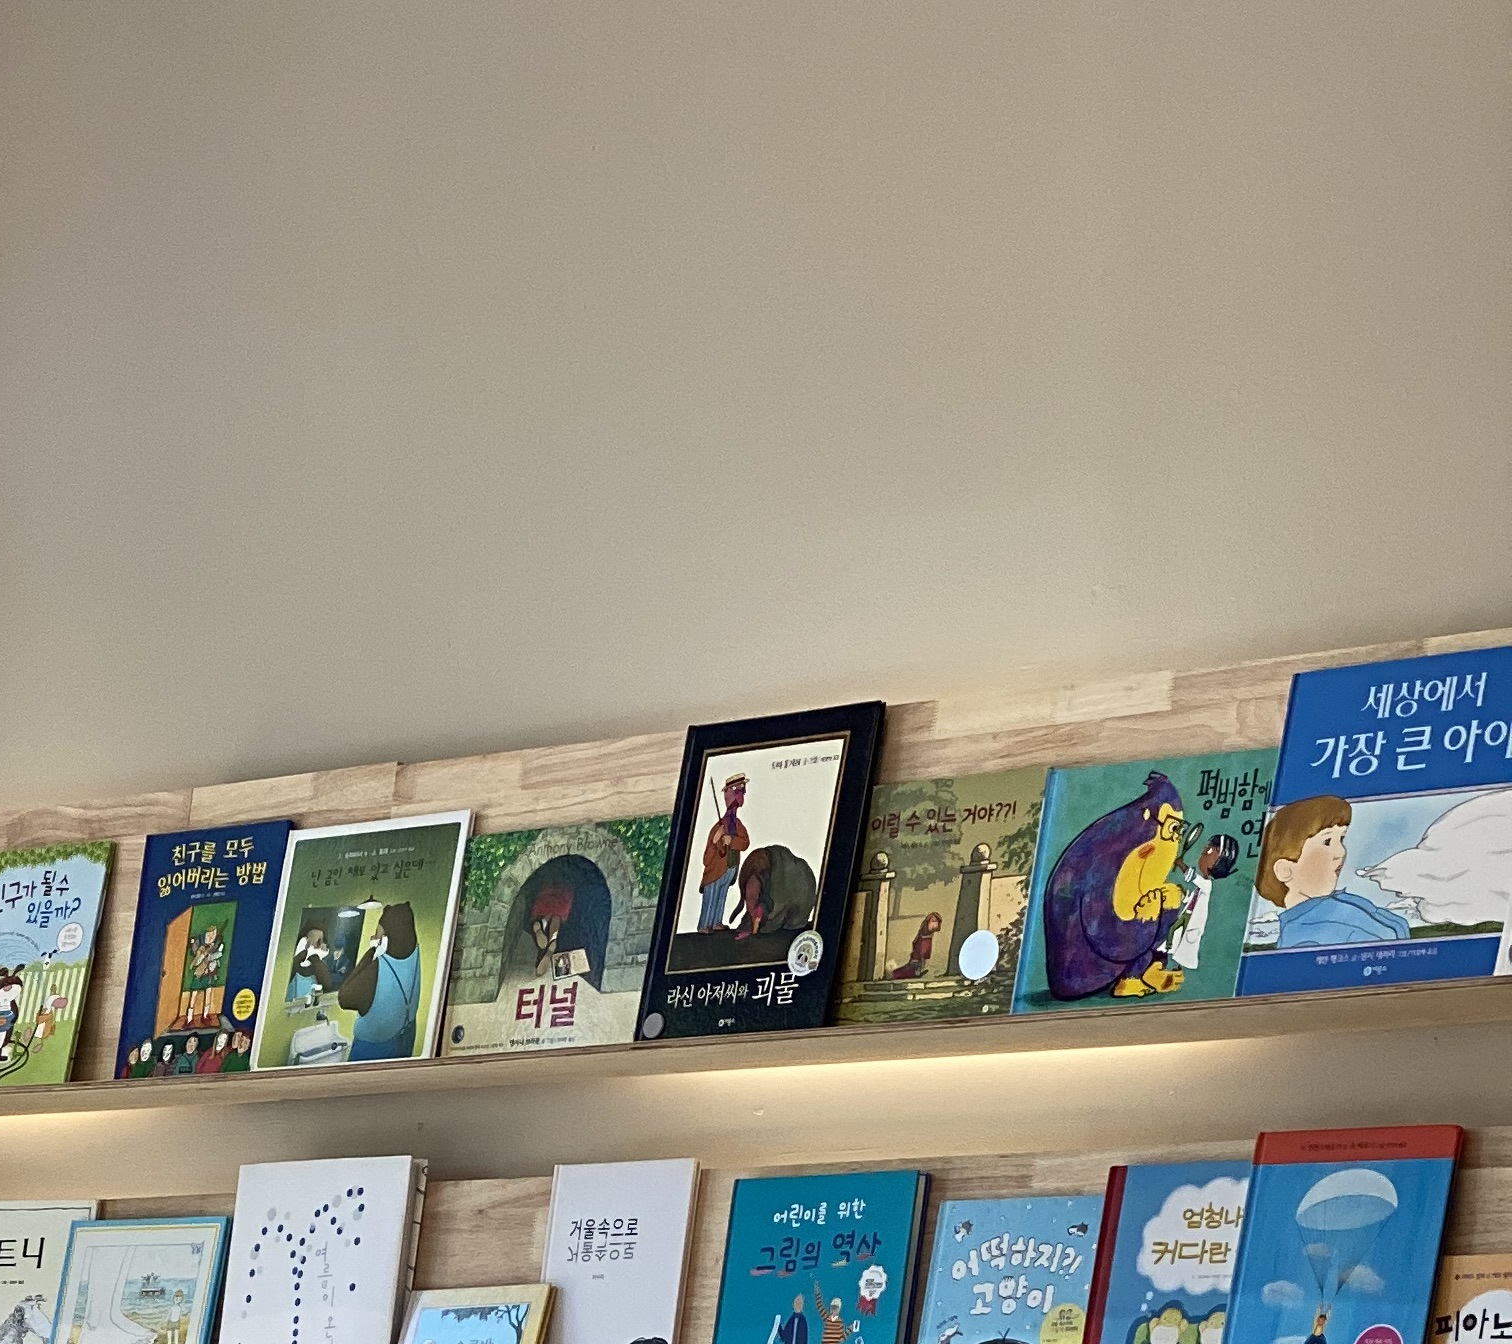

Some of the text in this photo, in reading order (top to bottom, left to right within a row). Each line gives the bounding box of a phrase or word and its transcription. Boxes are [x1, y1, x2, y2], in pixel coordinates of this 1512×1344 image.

[1361, 671, 1488, 719] 세상에서
[1310, 731, 1387, 779] 가장
[1396, 725, 1432, 771] 큰
[1197, 768, 1273, 819] 평범함에
[872, 811, 901, 839] 이럴
[906, 810, 921, 832] 수
[925, 807, 957, 835] 있는
[172, 836, 255, 866] 친구를 모두
[158, 862, 267, 897] 잃어버리는 방법
[26, 897, 81, 928] 있을까?
[515, 981, 579, 1029] 터널
[667, 972, 800, 1009] 라신 아저씨와 괴물
[569, 1217, 639, 1241] 거울속으로
[773, 1198, 866, 1228] 어린이를 위한
[1183, 1202, 1244, 1229] 엄청나
[756, 1229, 882, 1273] 그림의 역사
[1152, 1239, 1232, 1264] 커다란
[970, 1275, 1054, 1315] 고양이
[1435, 1309, 1512, 1341] 피아노
